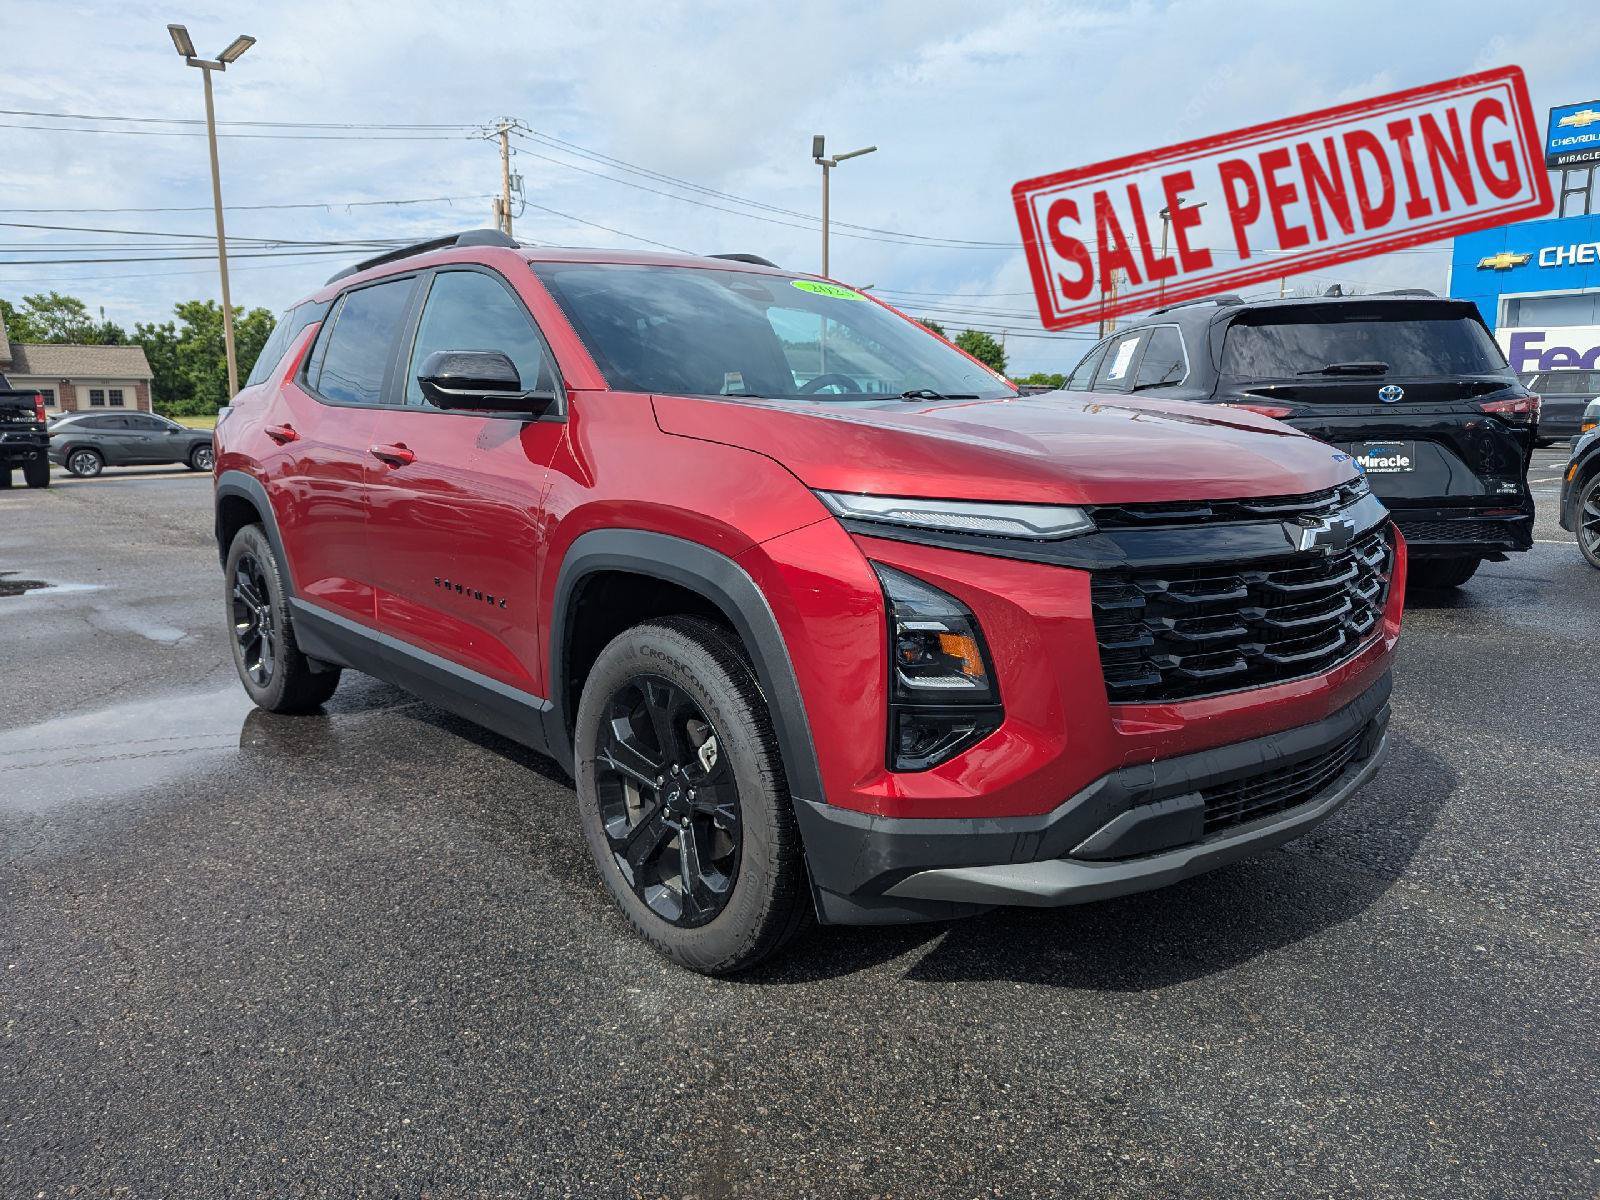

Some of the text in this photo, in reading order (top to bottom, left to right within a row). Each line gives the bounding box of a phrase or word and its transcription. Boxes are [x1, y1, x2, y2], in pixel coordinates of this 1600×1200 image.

[1552, 133, 1600, 147] CHEVROL
[1558, 152, 1600, 164] MIRACLE
[1539, 242, 1600, 267] CHE
[1357, 454, 1410, 467] Miracle
